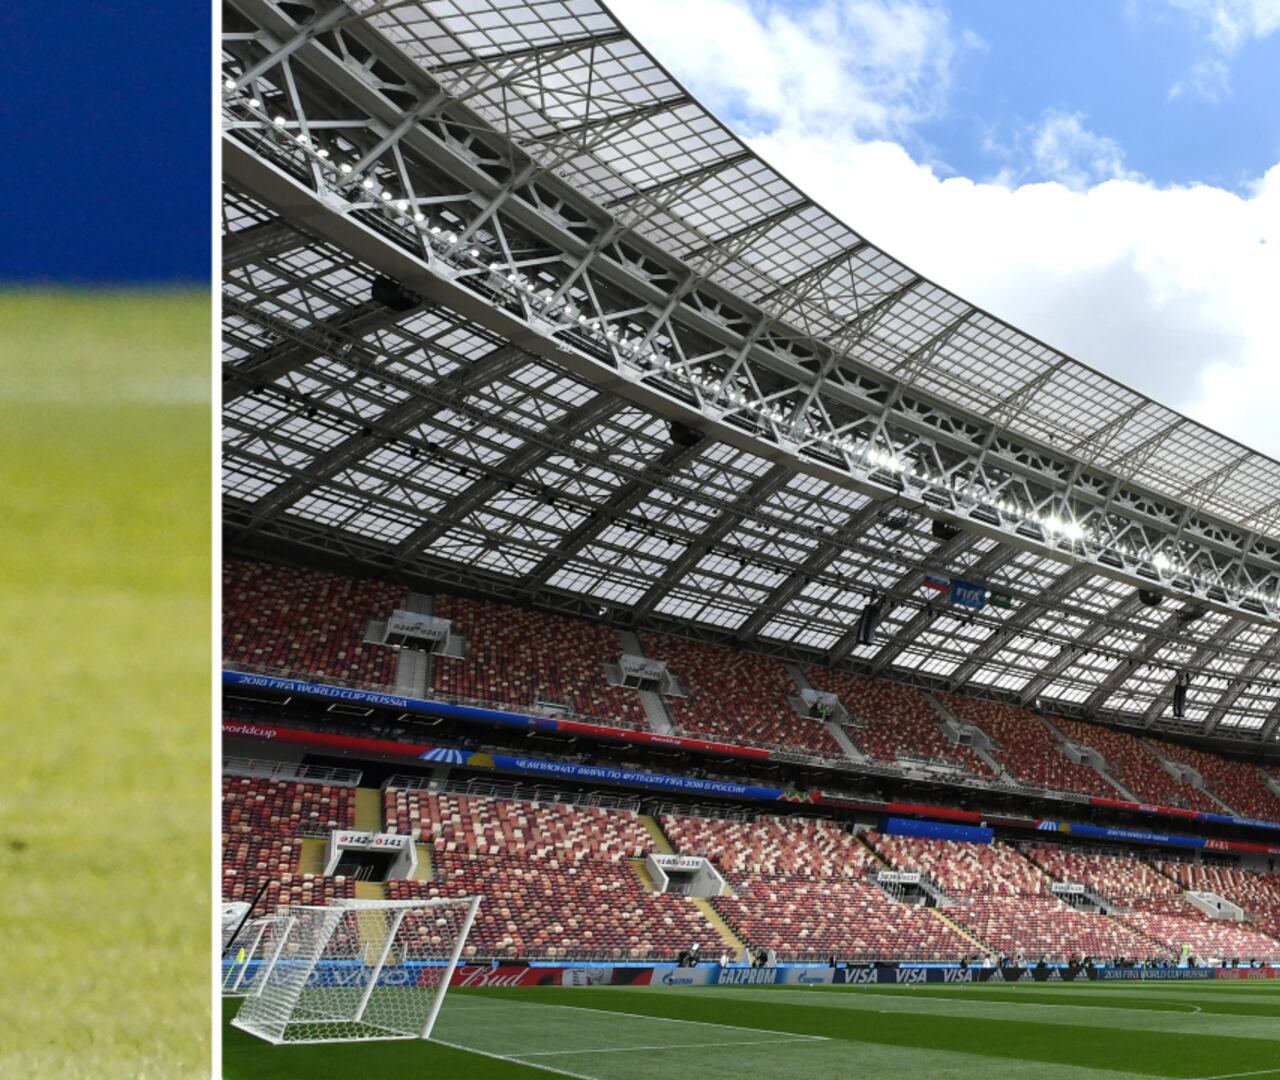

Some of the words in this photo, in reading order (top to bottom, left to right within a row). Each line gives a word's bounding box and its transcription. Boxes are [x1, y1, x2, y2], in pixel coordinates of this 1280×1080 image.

[238, 675, 269, 688] 2018
[270, 679, 294, 691] FIFA
[296, 683, 339, 698] WORLD
[339, 690, 365, 700] CUP
[365, 694, 407, 708] RUSSIA
[383, 838, 402, 847] 141
[458, 966, 530, 987] Bud
[717, 968, 777, 985] GAZPROM
[844, 968, 878, 984] VISA
[895, 968, 927, 984] VISA
[942, 968, 973, 983] VISA
